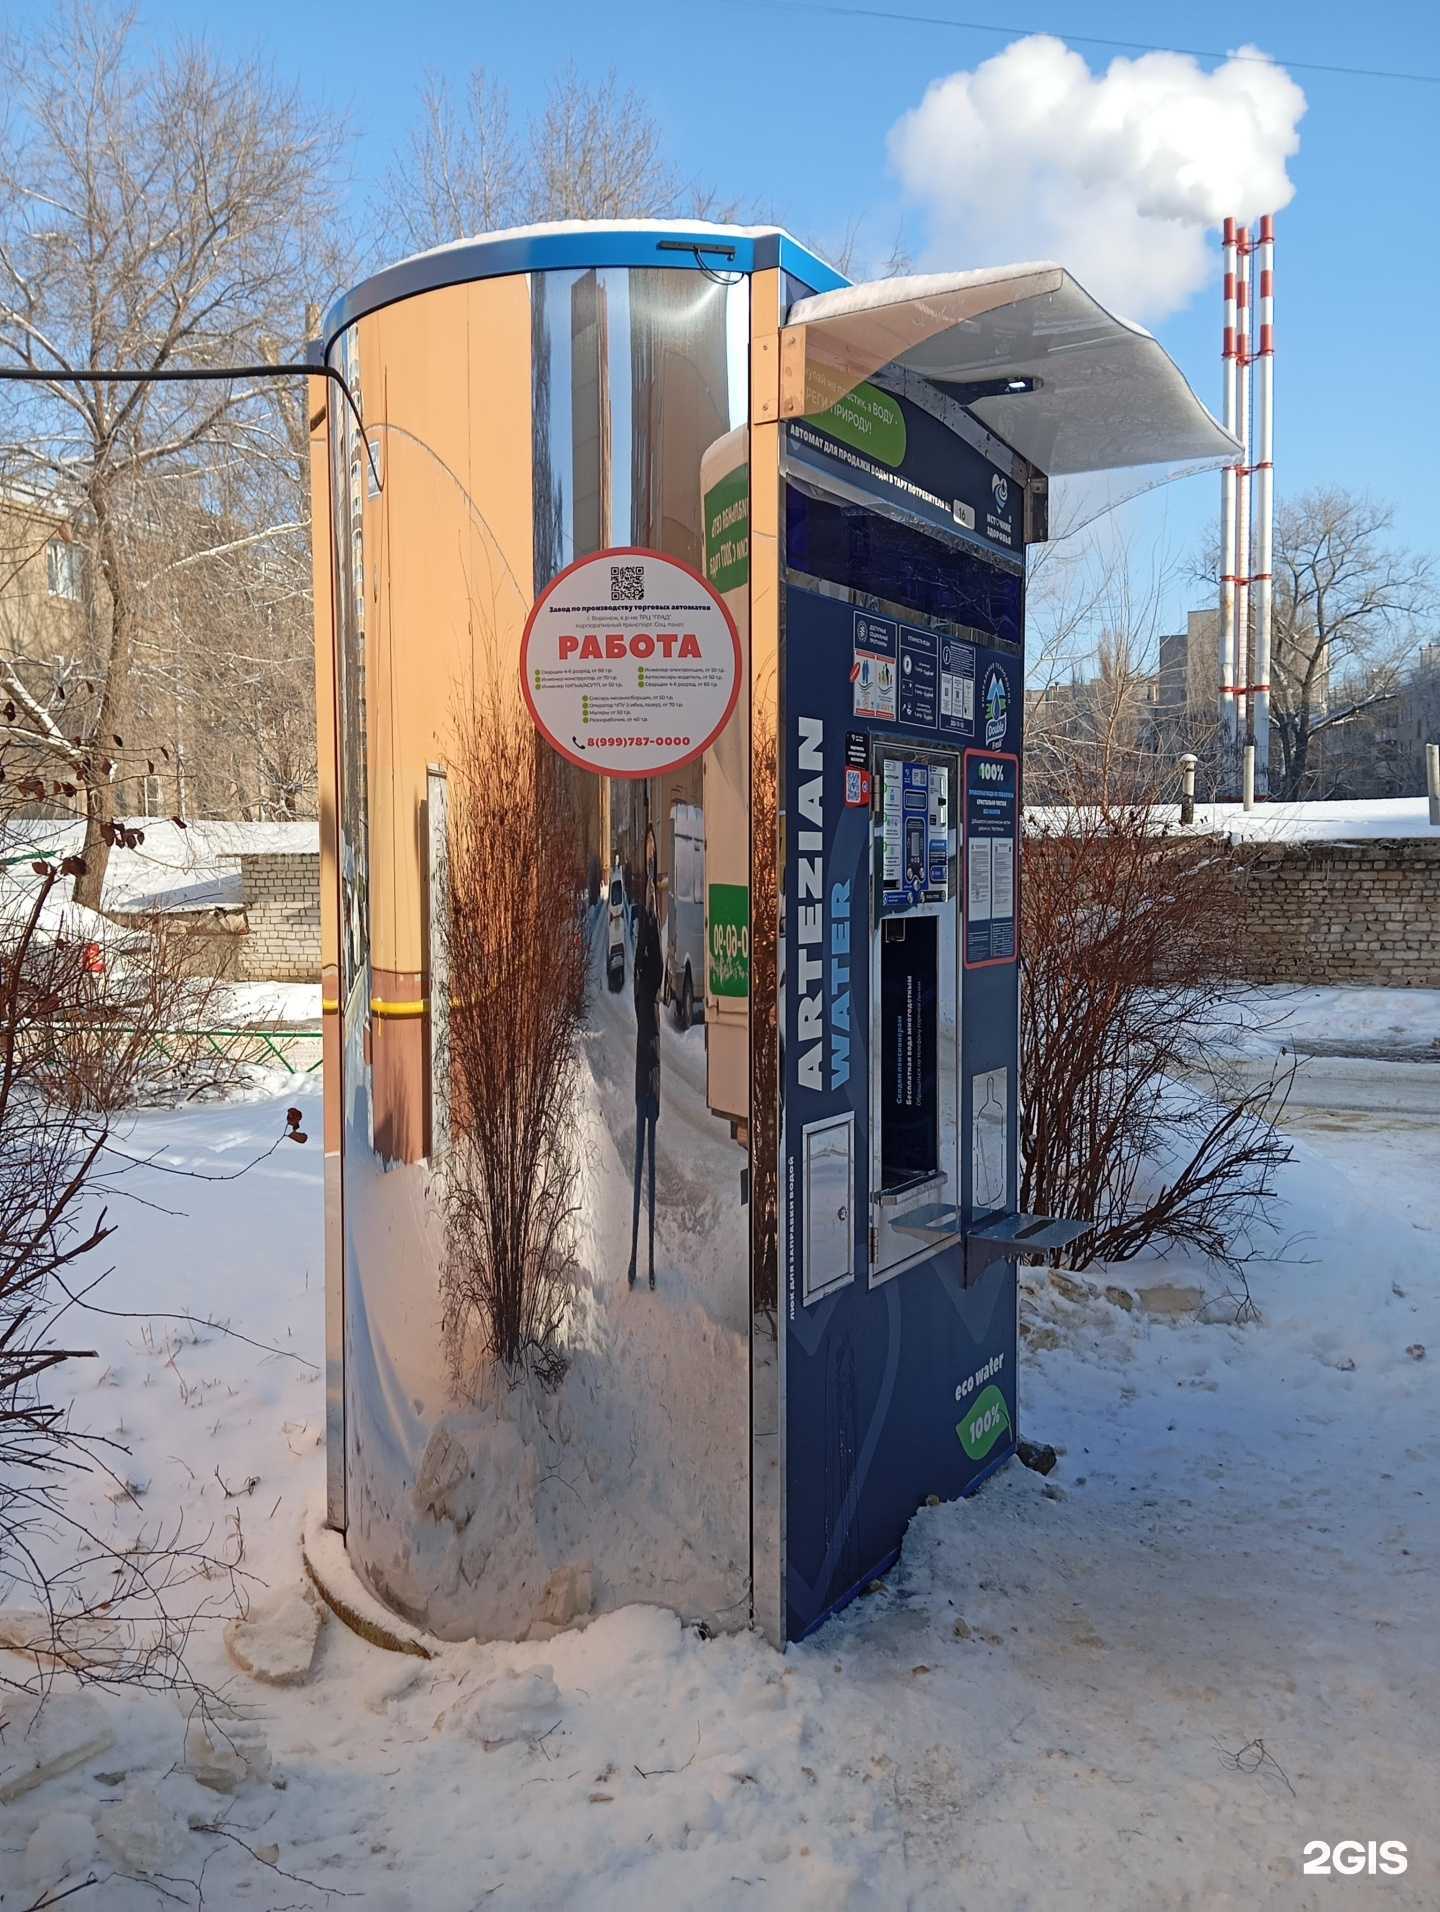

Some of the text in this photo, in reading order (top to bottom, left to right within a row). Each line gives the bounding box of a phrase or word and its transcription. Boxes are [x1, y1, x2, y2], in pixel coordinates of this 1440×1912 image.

[831, 404, 872, 435] ПРИРОДУ!
[873, 402, 894, 425] ВОДУ
[790, 424, 823, 448] АВТОМАТ
[823, 440, 838, 456] ДЛЯ
[838, 447, 871, 473] ПРОДАЖИ
[871, 464, 889, 481] ВОДЫ
[889, 474, 894, 484] В
[894, 476, 908, 490] ТАРУ
[907, 483, 945, 509] ПОТРЕБИТЕЛЯ
[987, 512, 1011, 533] ИСТОЧНИК
[987, 526, 1011, 545] ЗДОРОВЬЯ
[582, 603, 633, 612] производству
[633, 603, 670, 611] торговых
[558, 634, 702, 660] РАБОТА
[988, 721, 1004, 738] Double
[587, 737, 690, 748] 8(999)787-0000
[979, 762, 1004, 781] 100%
[798, 717, 824, 1092] ARTEZIAN
[831, 879, 851, 1091] WATER
[955, 1352, 1004, 1401] eco water
[969, 1402, 1000, 1445] 100%
